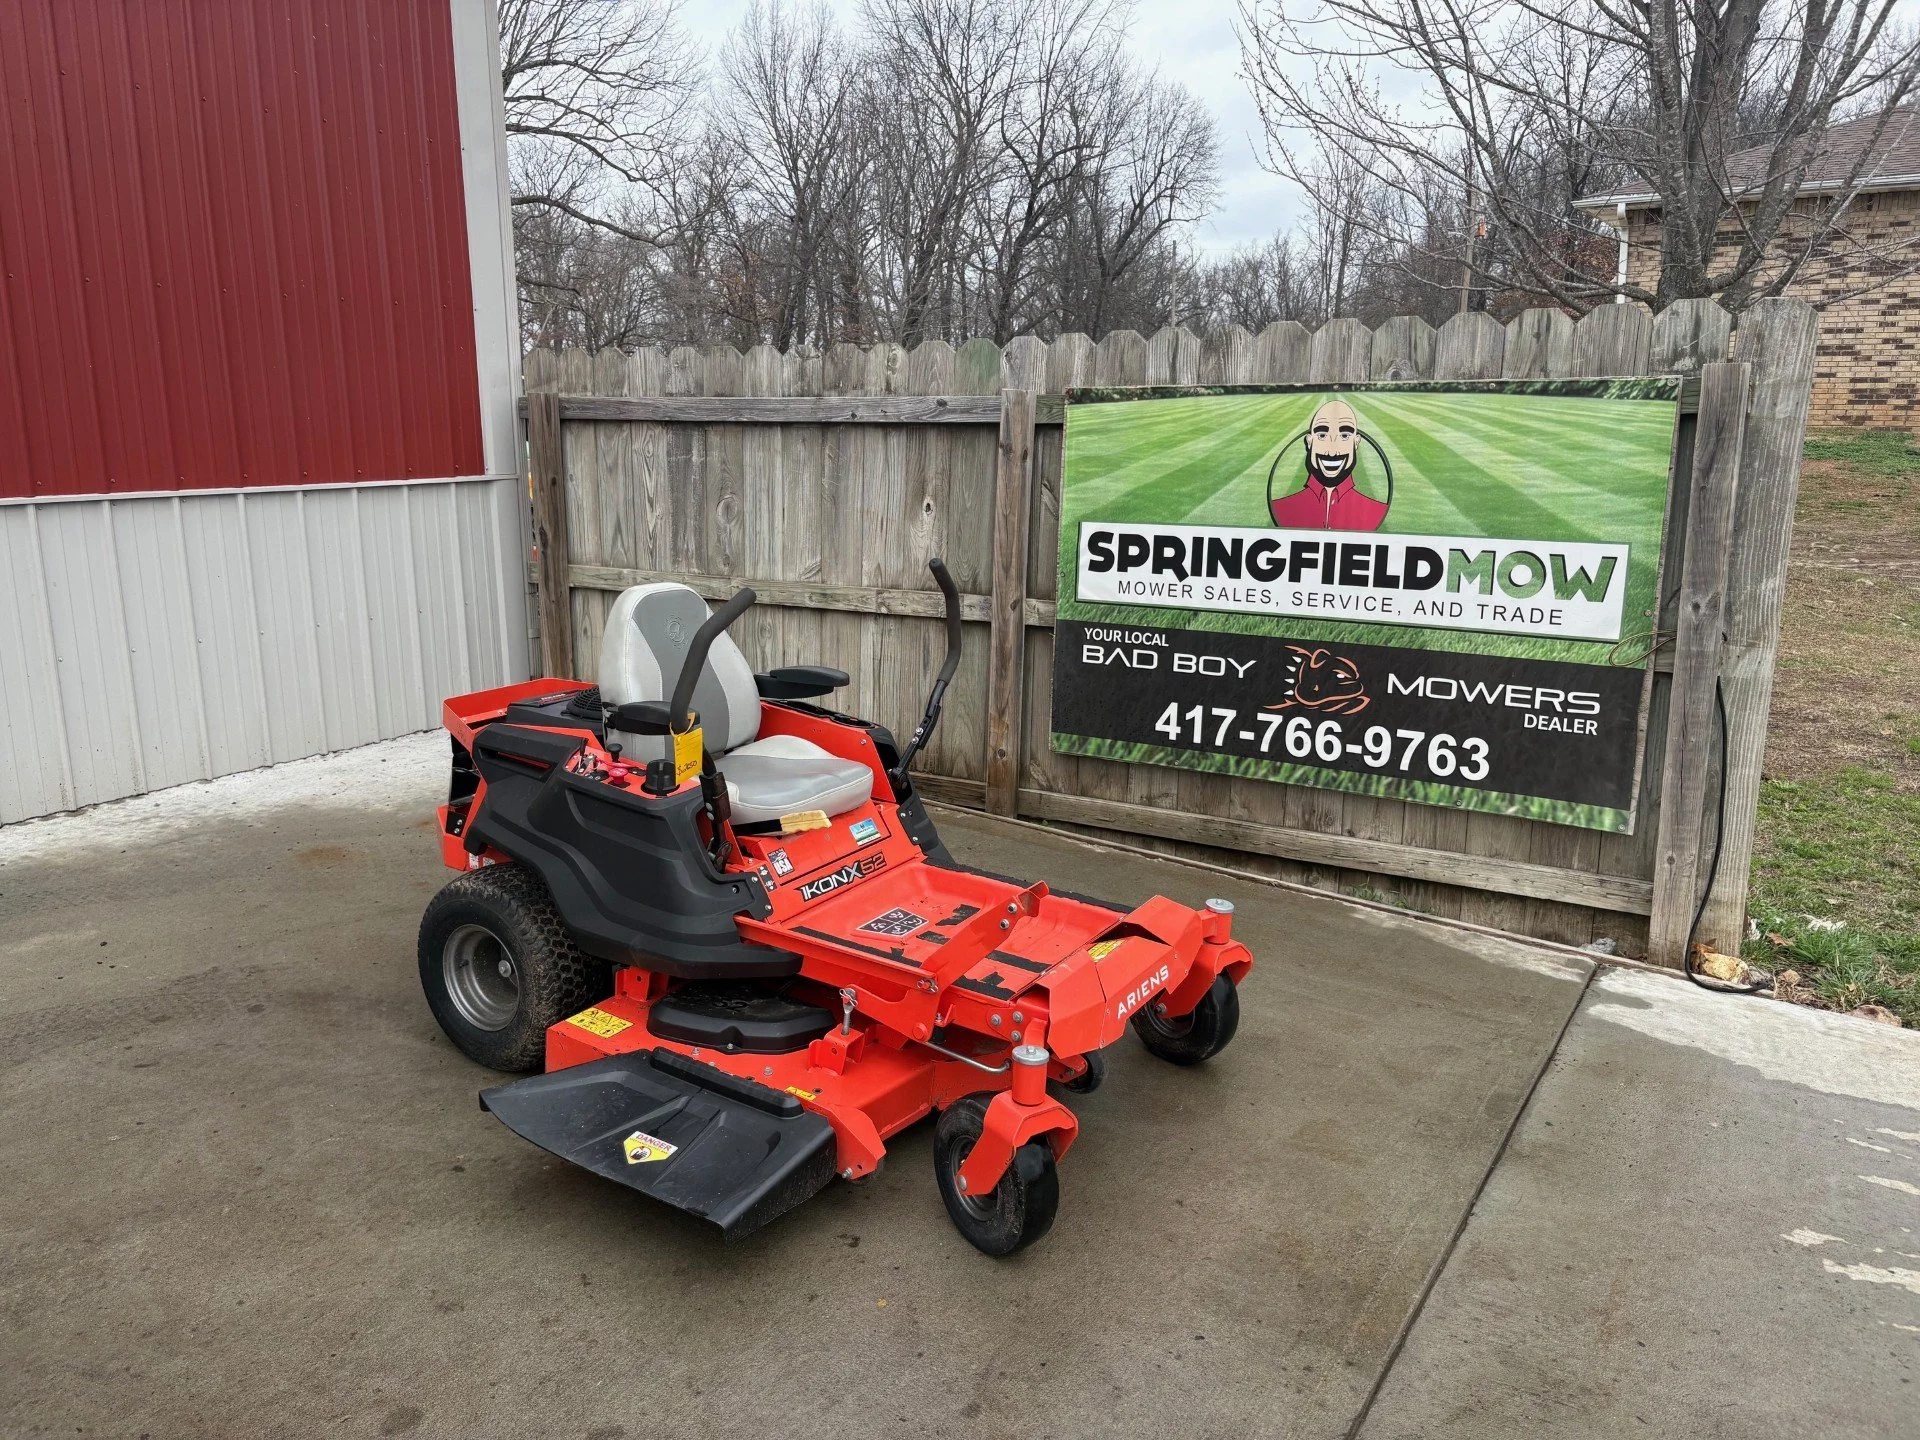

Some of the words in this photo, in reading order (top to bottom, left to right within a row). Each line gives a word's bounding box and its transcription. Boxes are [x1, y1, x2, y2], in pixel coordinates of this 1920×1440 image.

[1118, 580, 1193, 599] MOWER
[1204, 585, 1280, 607] SALES,
[1291, 591, 1401, 616] SERVICE,
[1413, 599, 1463, 618] AND
[1476, 603, 1563, 625] TRADE
[1084, 627, 1122, 643] YOUR
[1124, 631, 1170, 647] LOCAL
[1082, 644, 1159, 670] BAD
[1173, 652, 1257, 679] BOY
[1387, 672, 1601, 715] MOWERS
[1154, 701, 1490, 782] 417-766-9763
[1523, 713, 1599, 736] DEALER
[772, 857, 795, 877] USA
[1117, 965, 1169, 1020] ARIENS
[636, 1133, 673, 1152] DANGER
